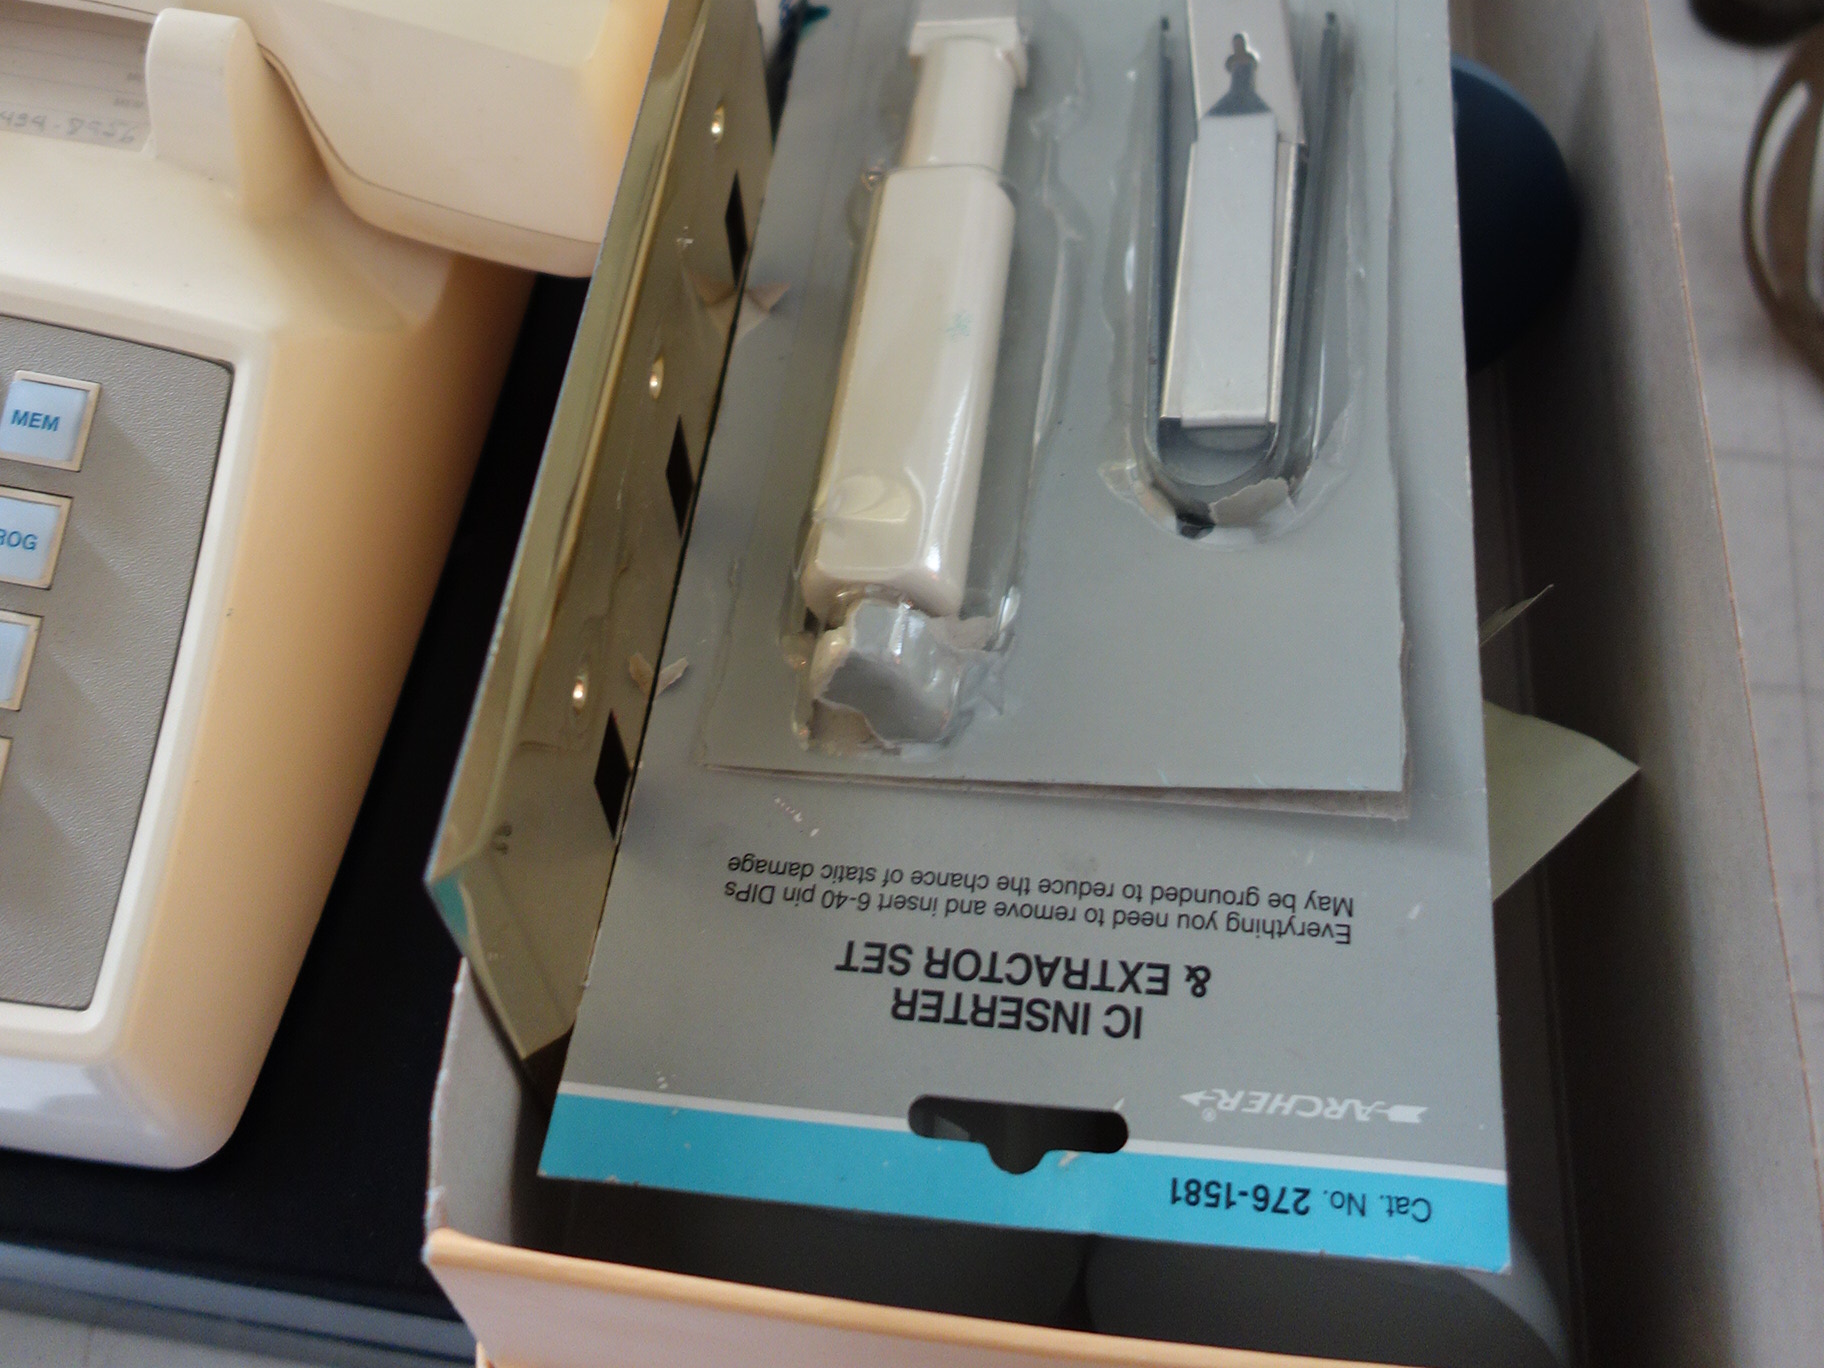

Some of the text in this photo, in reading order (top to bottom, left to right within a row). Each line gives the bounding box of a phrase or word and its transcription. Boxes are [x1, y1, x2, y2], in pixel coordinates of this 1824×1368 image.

[11, 409, 60, 432] MEM
[724, 881, 1354, 946] Everything you need to remove and insert 6-40 pin DIPs
[728, 853, 1355, 919] May be grounded to reduce the chance of static damage
[834, 940, 1212, 998] & EXTRACTOR SET
[890, 987, 1144, 1040] IC INSERTER
[1170, 1177, 1432, 1224] Cat. No. 276-1581
